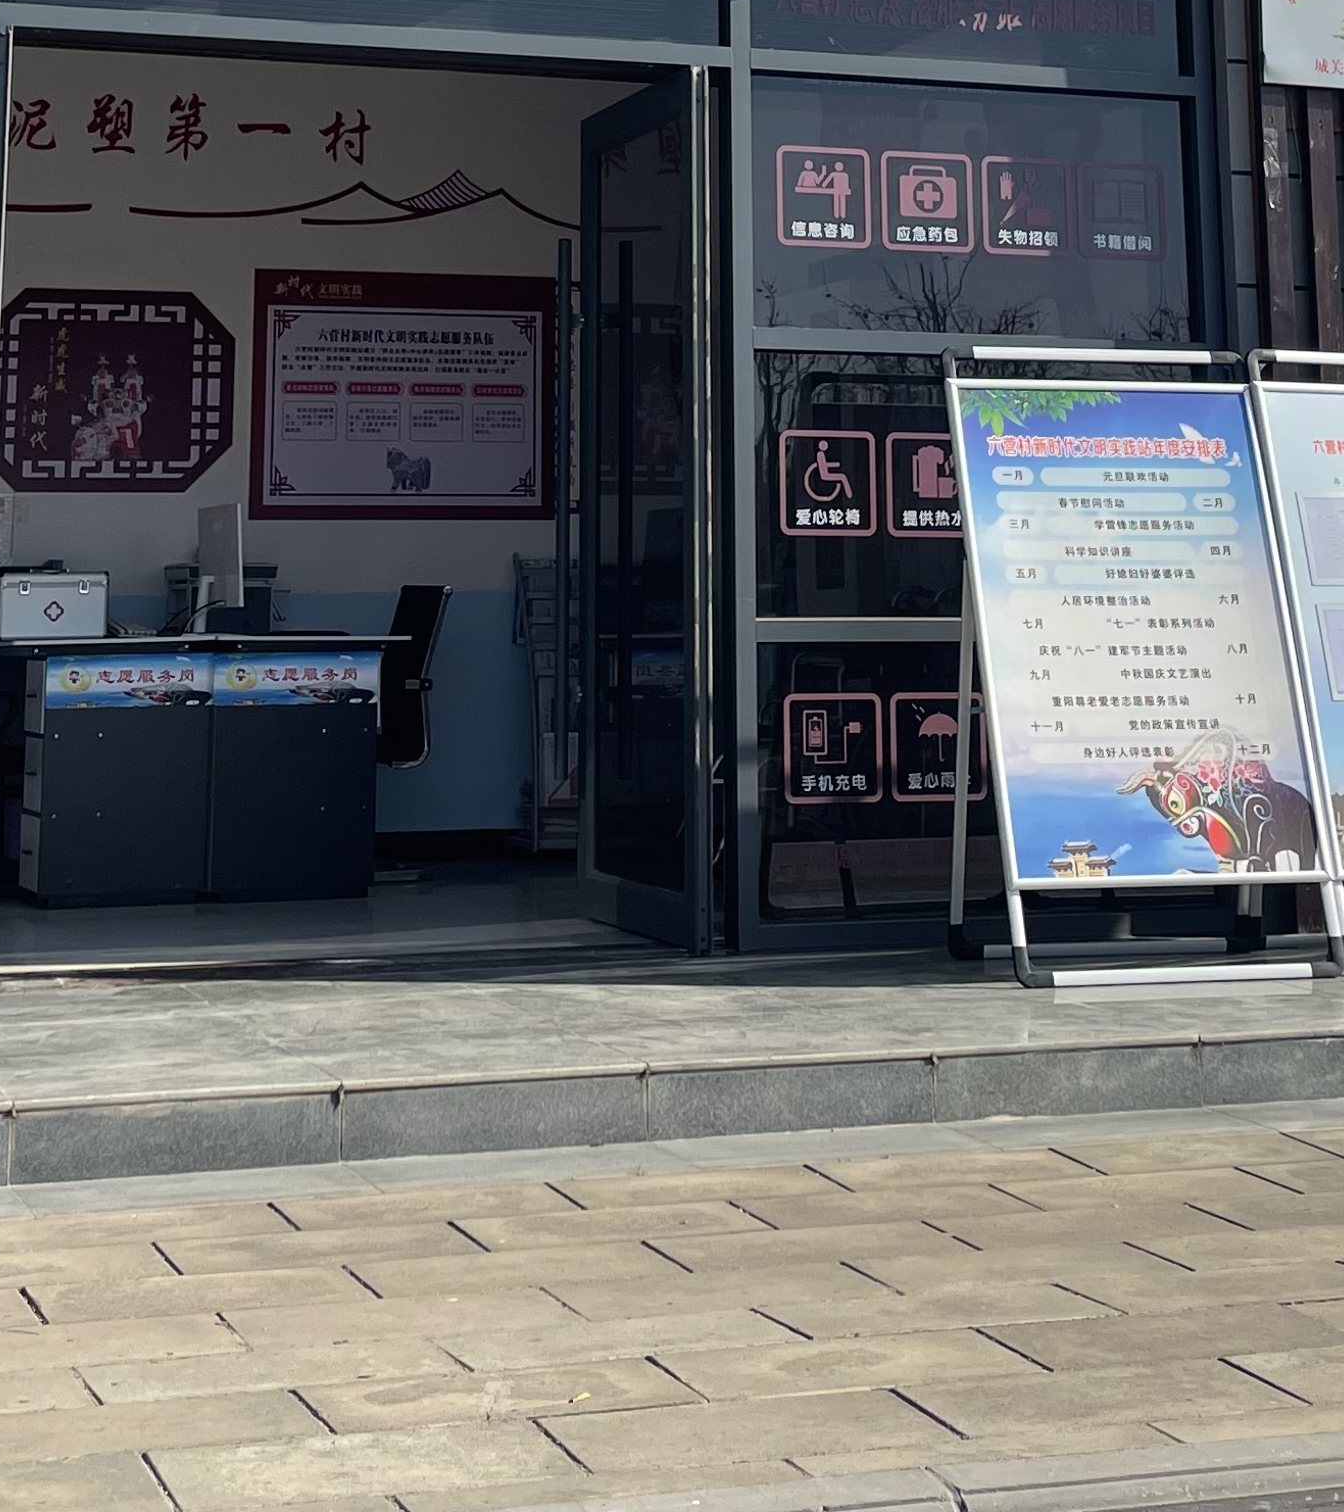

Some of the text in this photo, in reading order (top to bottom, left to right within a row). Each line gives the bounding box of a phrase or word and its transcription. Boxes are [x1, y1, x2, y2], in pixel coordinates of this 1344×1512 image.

[9, 93, 372, 166] 泥塑第一村
[791, 221, 855, 240] 信息咨询
[896, 226, 959, 243] 应急药包
[997, 229, 1059, 247] 失物招领
[1092, 234, 1153, 251] 书籍借阅
[29, 383, 50, 451] 新时代
[986, 435, 1227, 459] 六营村新时代文明实践站年度安排表
[1002, 470, 1023, 481] 一月
[1102, 471, 1169, 483] 元旦联欢活动
[1058, 497, 1125, 509] 春节慰问活动
[1202, 497, 1224, 509] 二月
[795, 508, 861, 526] 爱心轮椅
[1008, 519, 1030, 530] 三月
[1064, 545, 1132, 557] 科学知识讲座
[1210, 545, 1231, 557] 四月
[1016, 568, 1037, 579] 五月
[1061, 594, 1151, 607] 人居环境整治活动
[1218, 593, 1240, 605] 六月
[1022, 618, 1044, 630] 七月
[1226, 642, 1249, 654] 八月
[96, 668, 195, 685] 志愿服务岗
[263, 667, 359, 683] 志愿服务岗
[1029, 669, 1051, 680] 九月
[1120, 668, 1212, 680] 中秋国庆文艺演出
[1234, 693, 1257, 705] 十月
[1030, 721, 1065, 733] 十一月
[1238, 743, 1271, 756] 十二月
[800, 773, 868, 792] 手机充电
